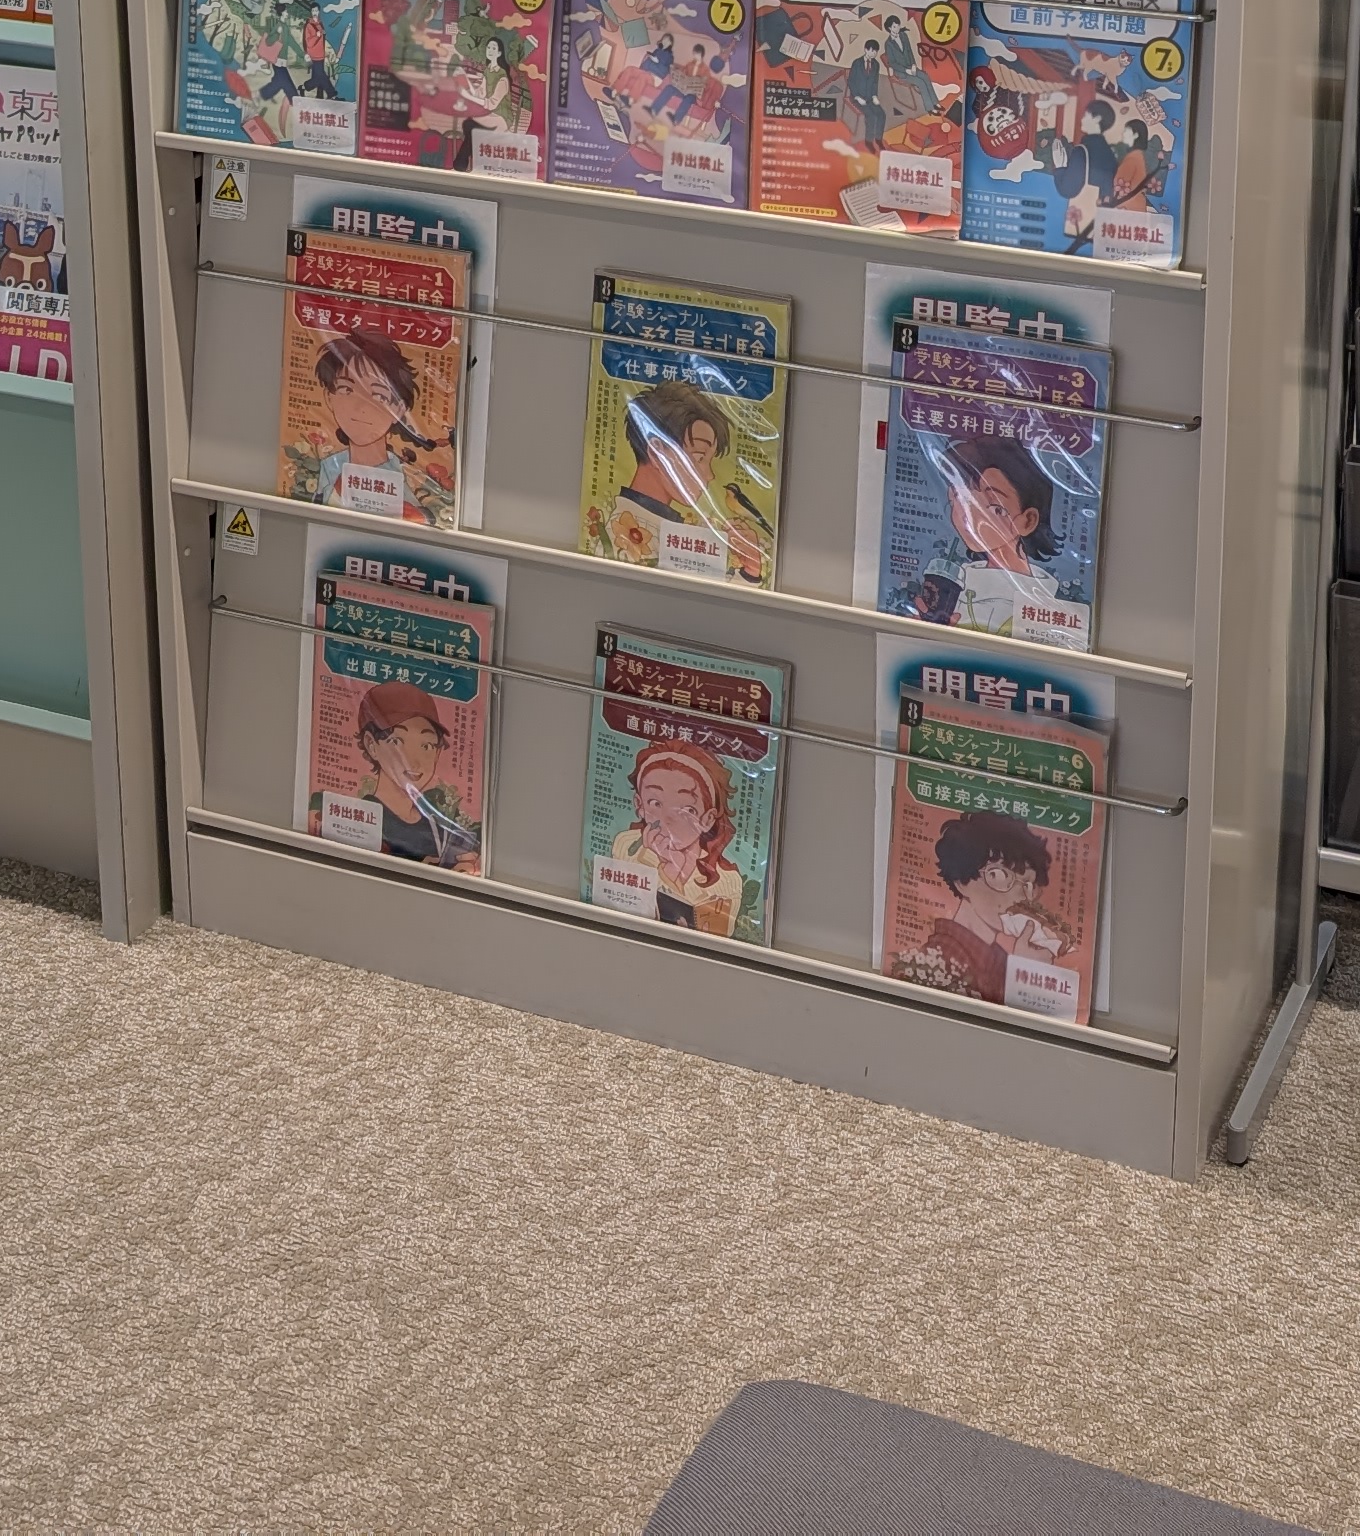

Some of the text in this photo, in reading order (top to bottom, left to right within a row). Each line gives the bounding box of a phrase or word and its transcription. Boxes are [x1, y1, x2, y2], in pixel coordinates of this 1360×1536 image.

[1010, 5, 1146, 35] 直前予想問題
[766, 95, 835, 109] プレゼンテーション
[298, 110, 350, 129] 持出禁止
[479, 142, 532, 163] 持出禁止
[670, 151, 725, 174] 持出禁止
[886, 165, 945, 189] 持出禁止
[1101, 221, 1165, 244] 持出禁止
[302, 253, 392, 279] 受験ジャーナル
[301, 305, 443, 342] 学習スタートブック
[611, 298, 708, 328] 受験ジャーナル
[913, 346, 1018, 378] 受験ジャーナル
[348, 474, 398, 497] 持出禁止
[666, 533, 721, 558] 持出禁止
[332, 601, 419, 632] 受験ジャーナル
[1021, 604, 1082, 630] 持出禁止
[346, 658, 455, 692] 出題予想ブック
[613, 655, 704, 690] 受験ジャーナル
[626, 714, 744, 752] 直前対策ブック
[918, 724, 1022, 758] 受験ジャーナル
[328, 802, 377, 827] 持出禁止
[916, 780, 1082, 828] 面接完全攻略ブック
[600, 866, 651, 892] 持出禁止
[1015, 967, 1073, 997] 持出禁止
